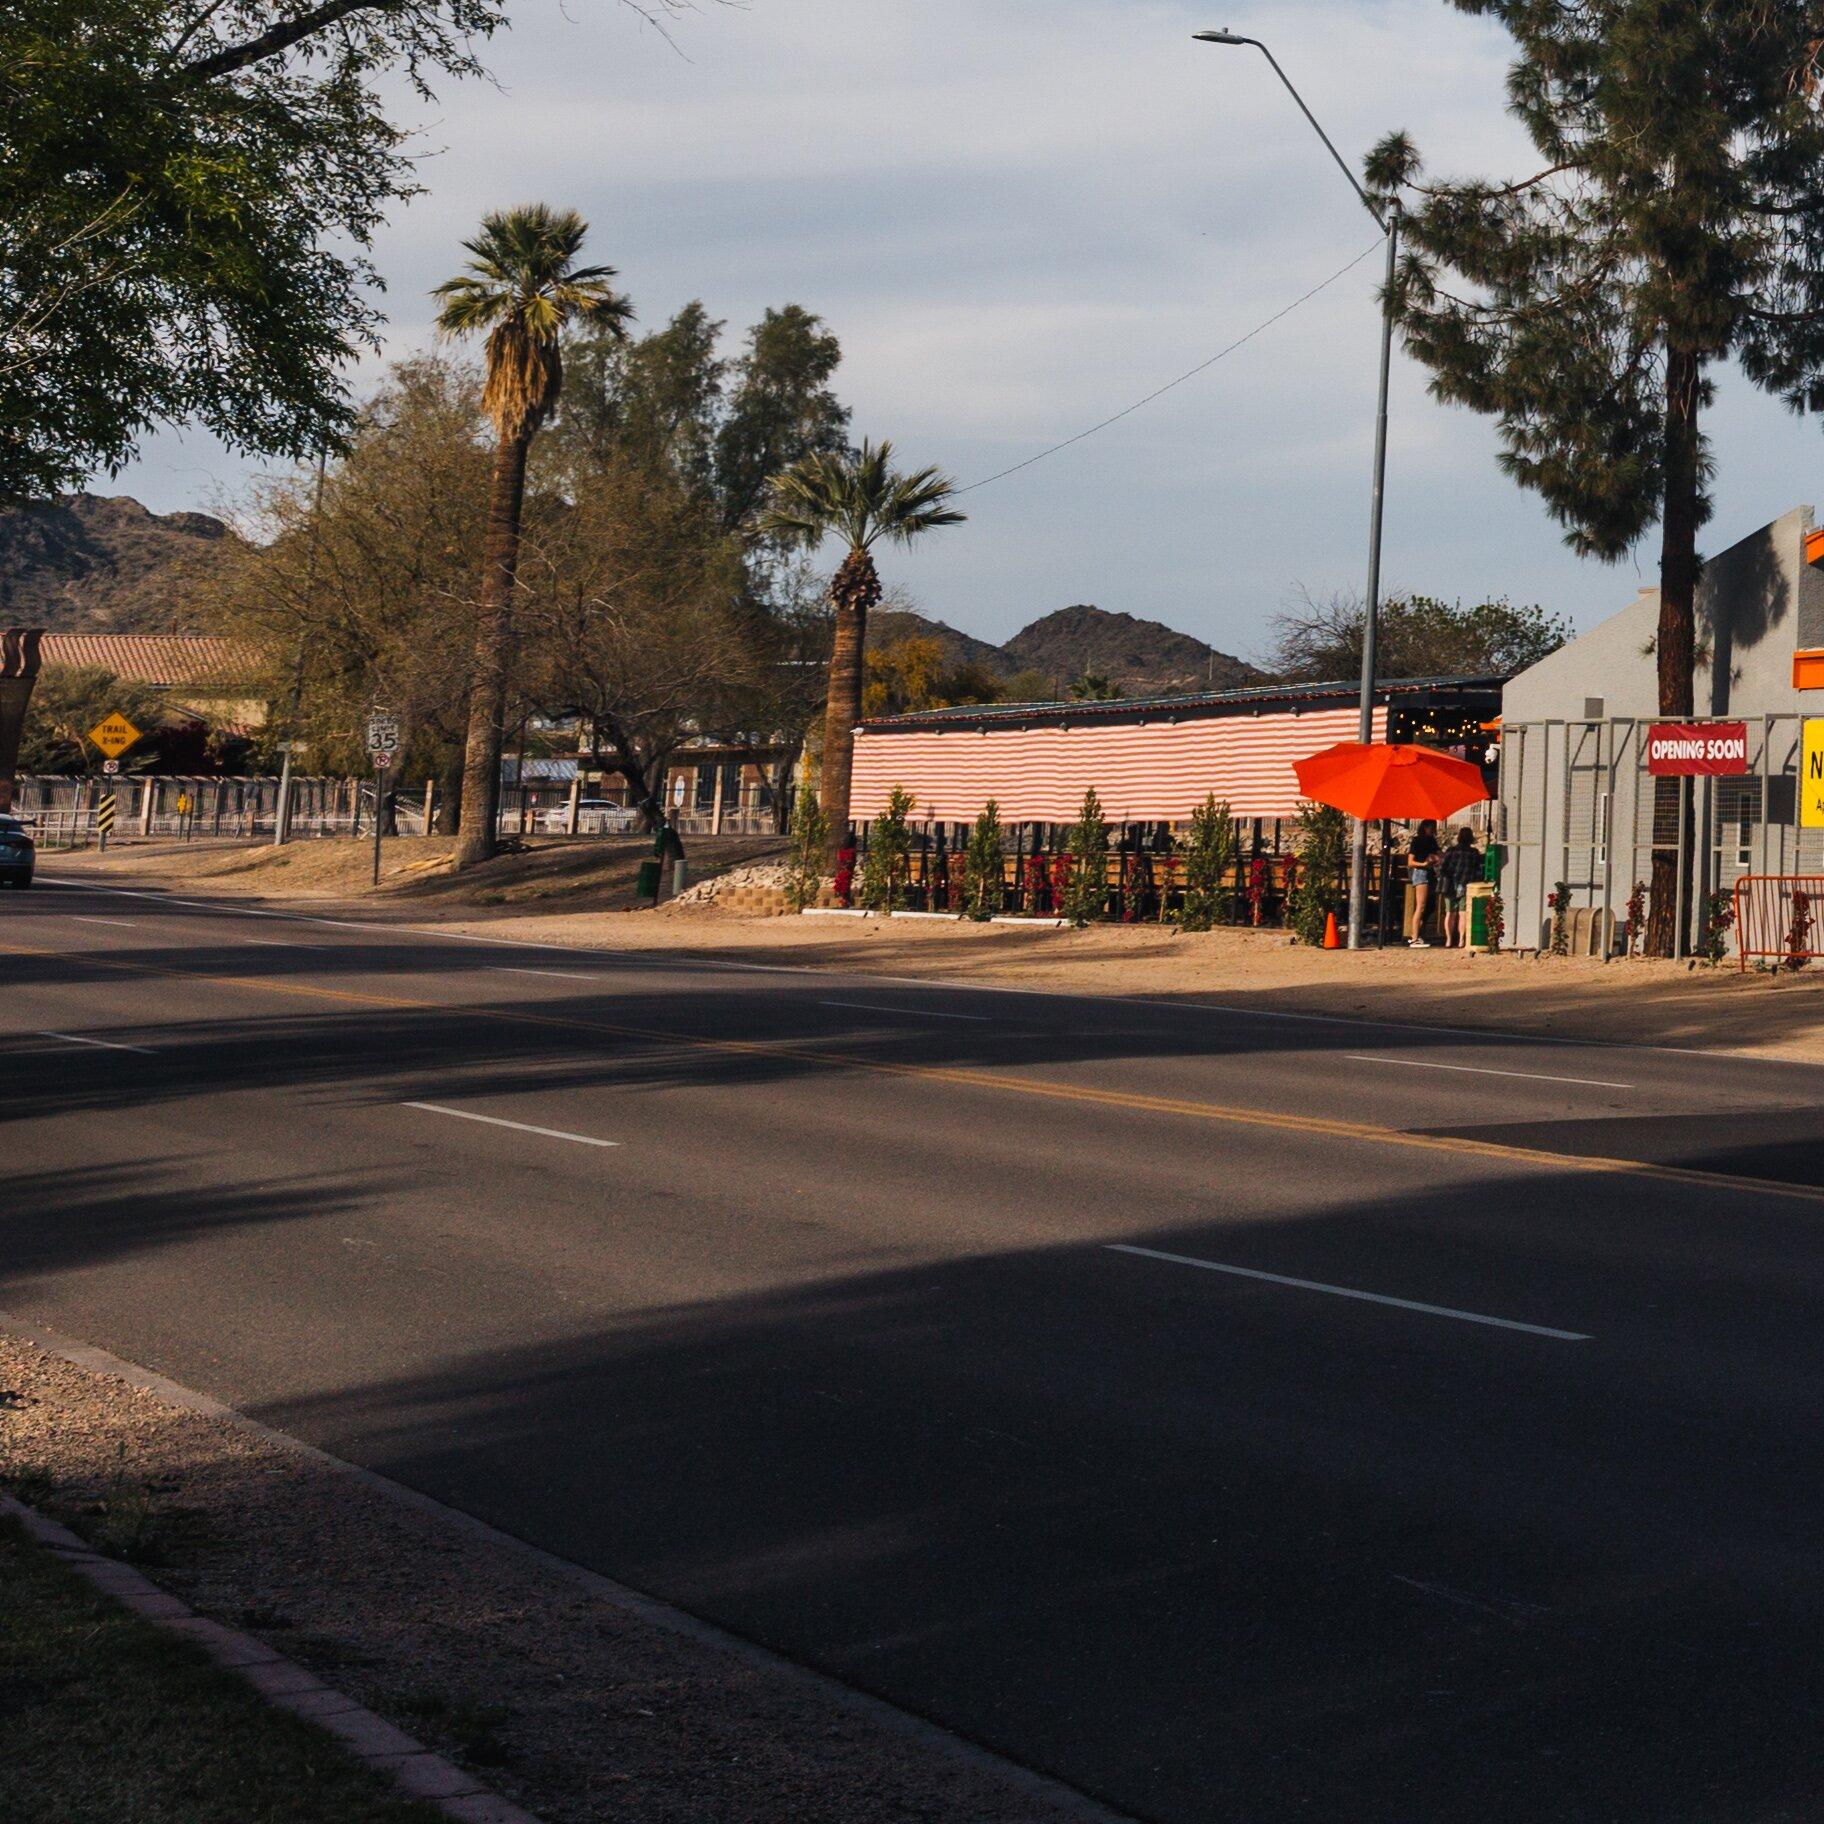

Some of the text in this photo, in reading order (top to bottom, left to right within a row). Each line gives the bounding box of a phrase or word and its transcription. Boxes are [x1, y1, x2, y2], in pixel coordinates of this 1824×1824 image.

[102, 725, 127, 733] TRAIL
[102, 736, 126, 745] X-ING
[370, 732, 396, 749] 35
[1651, 739, 1744, 760] OPENING SOON
